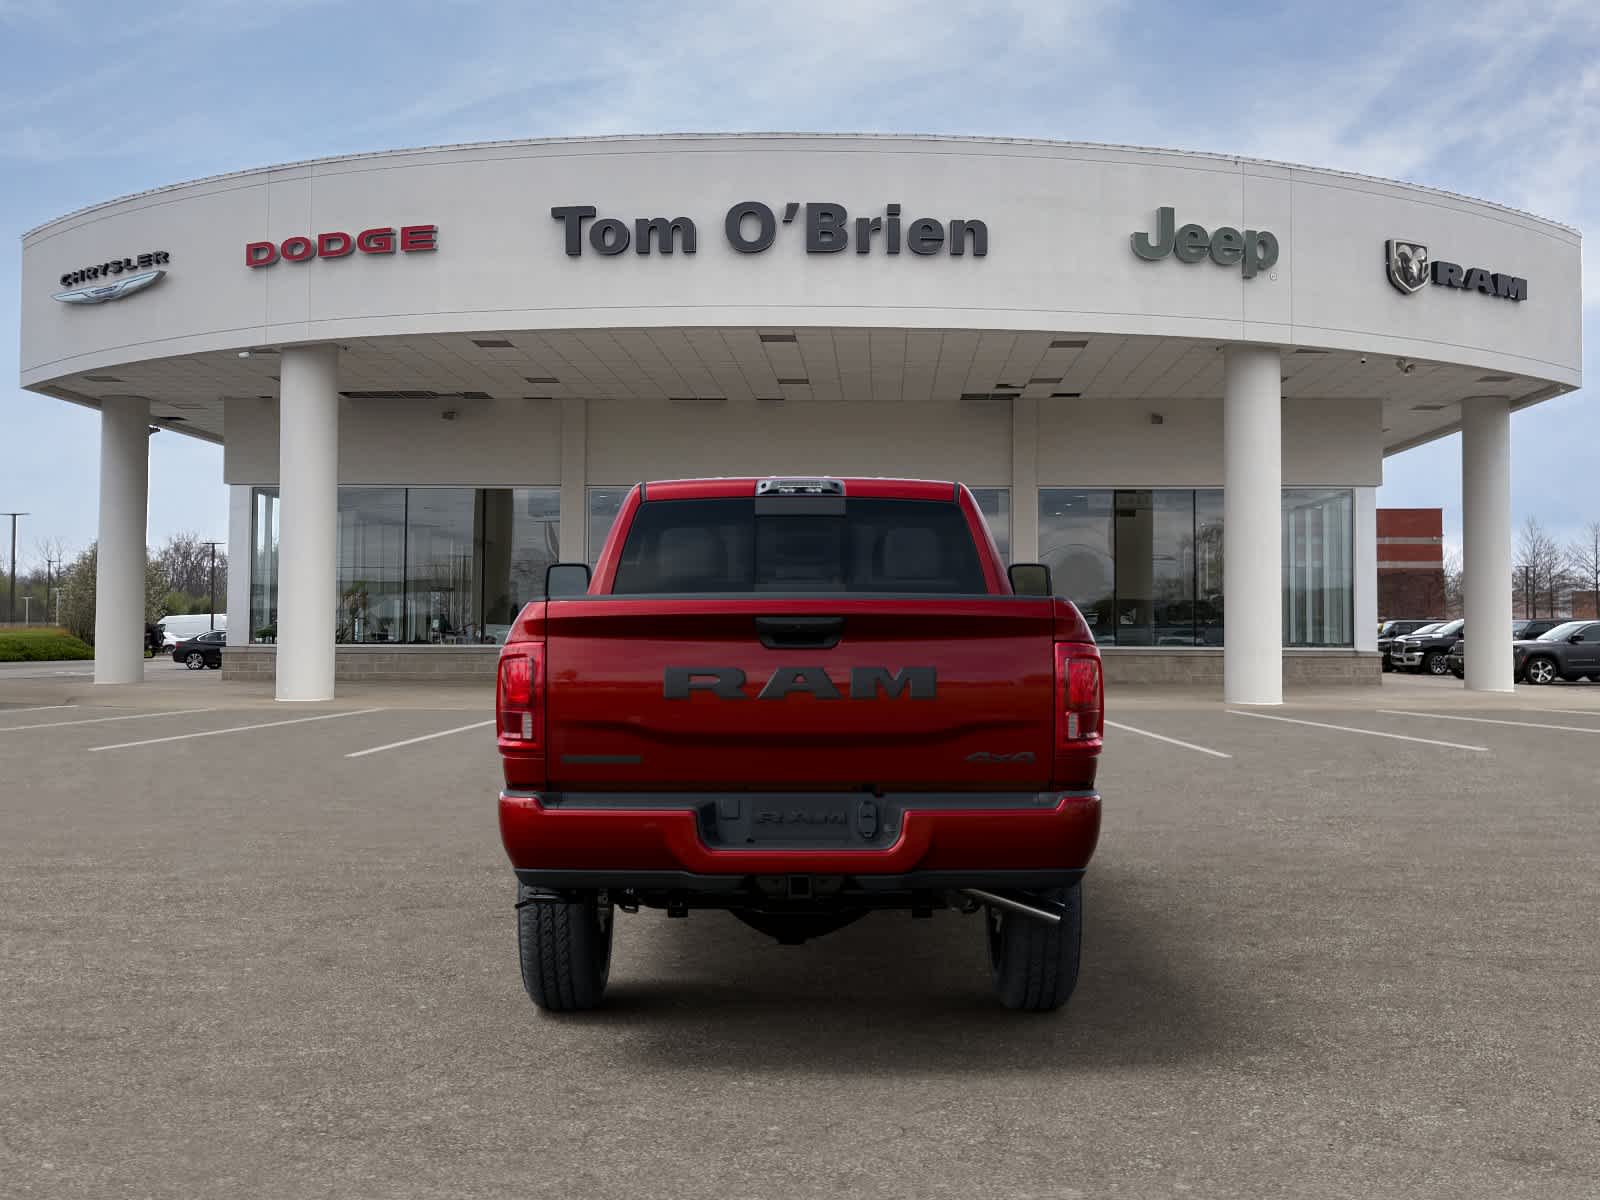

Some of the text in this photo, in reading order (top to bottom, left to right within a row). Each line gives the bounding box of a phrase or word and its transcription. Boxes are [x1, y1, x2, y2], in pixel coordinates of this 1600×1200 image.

[246, 225, 438, 268] DODGE
[551, 200, 987, 257] Tom O'Brien
[1131, 206, 1279, 279] Jeep
[60, 250, 170, 287] CHRYSLER
[1431, 261, 1527, 301] RAM
[663, 667, 937, 699] RAM
